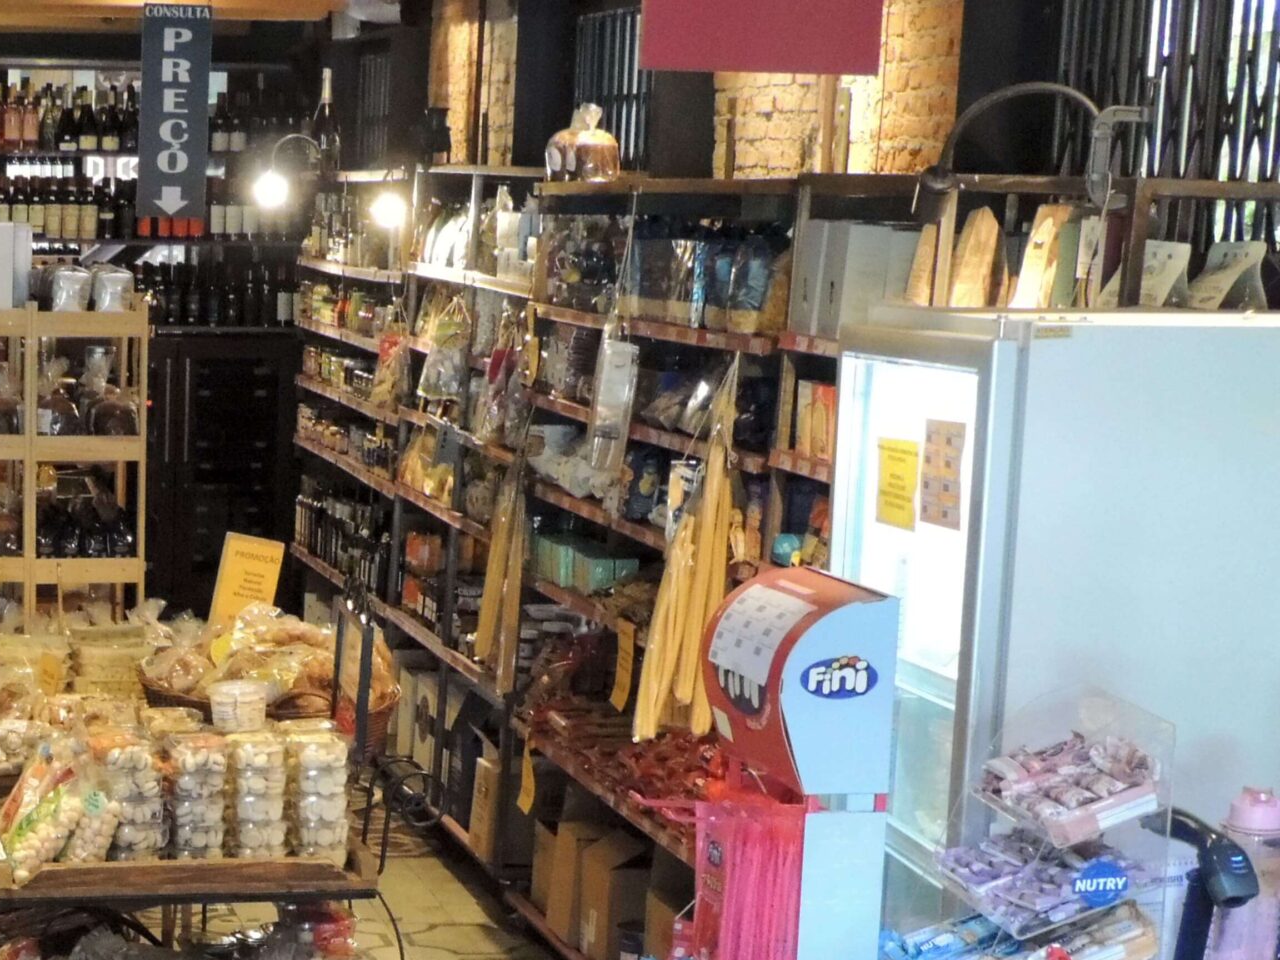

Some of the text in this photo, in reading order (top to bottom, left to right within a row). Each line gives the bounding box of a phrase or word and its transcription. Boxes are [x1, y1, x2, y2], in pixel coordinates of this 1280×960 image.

[145, 5, 210, 19] CONSULTA
[156, 27, 193, 174] PREÇO
[807, 659, 869, 695] Fini
[1074, 876, 1127, 893] NUTRY
